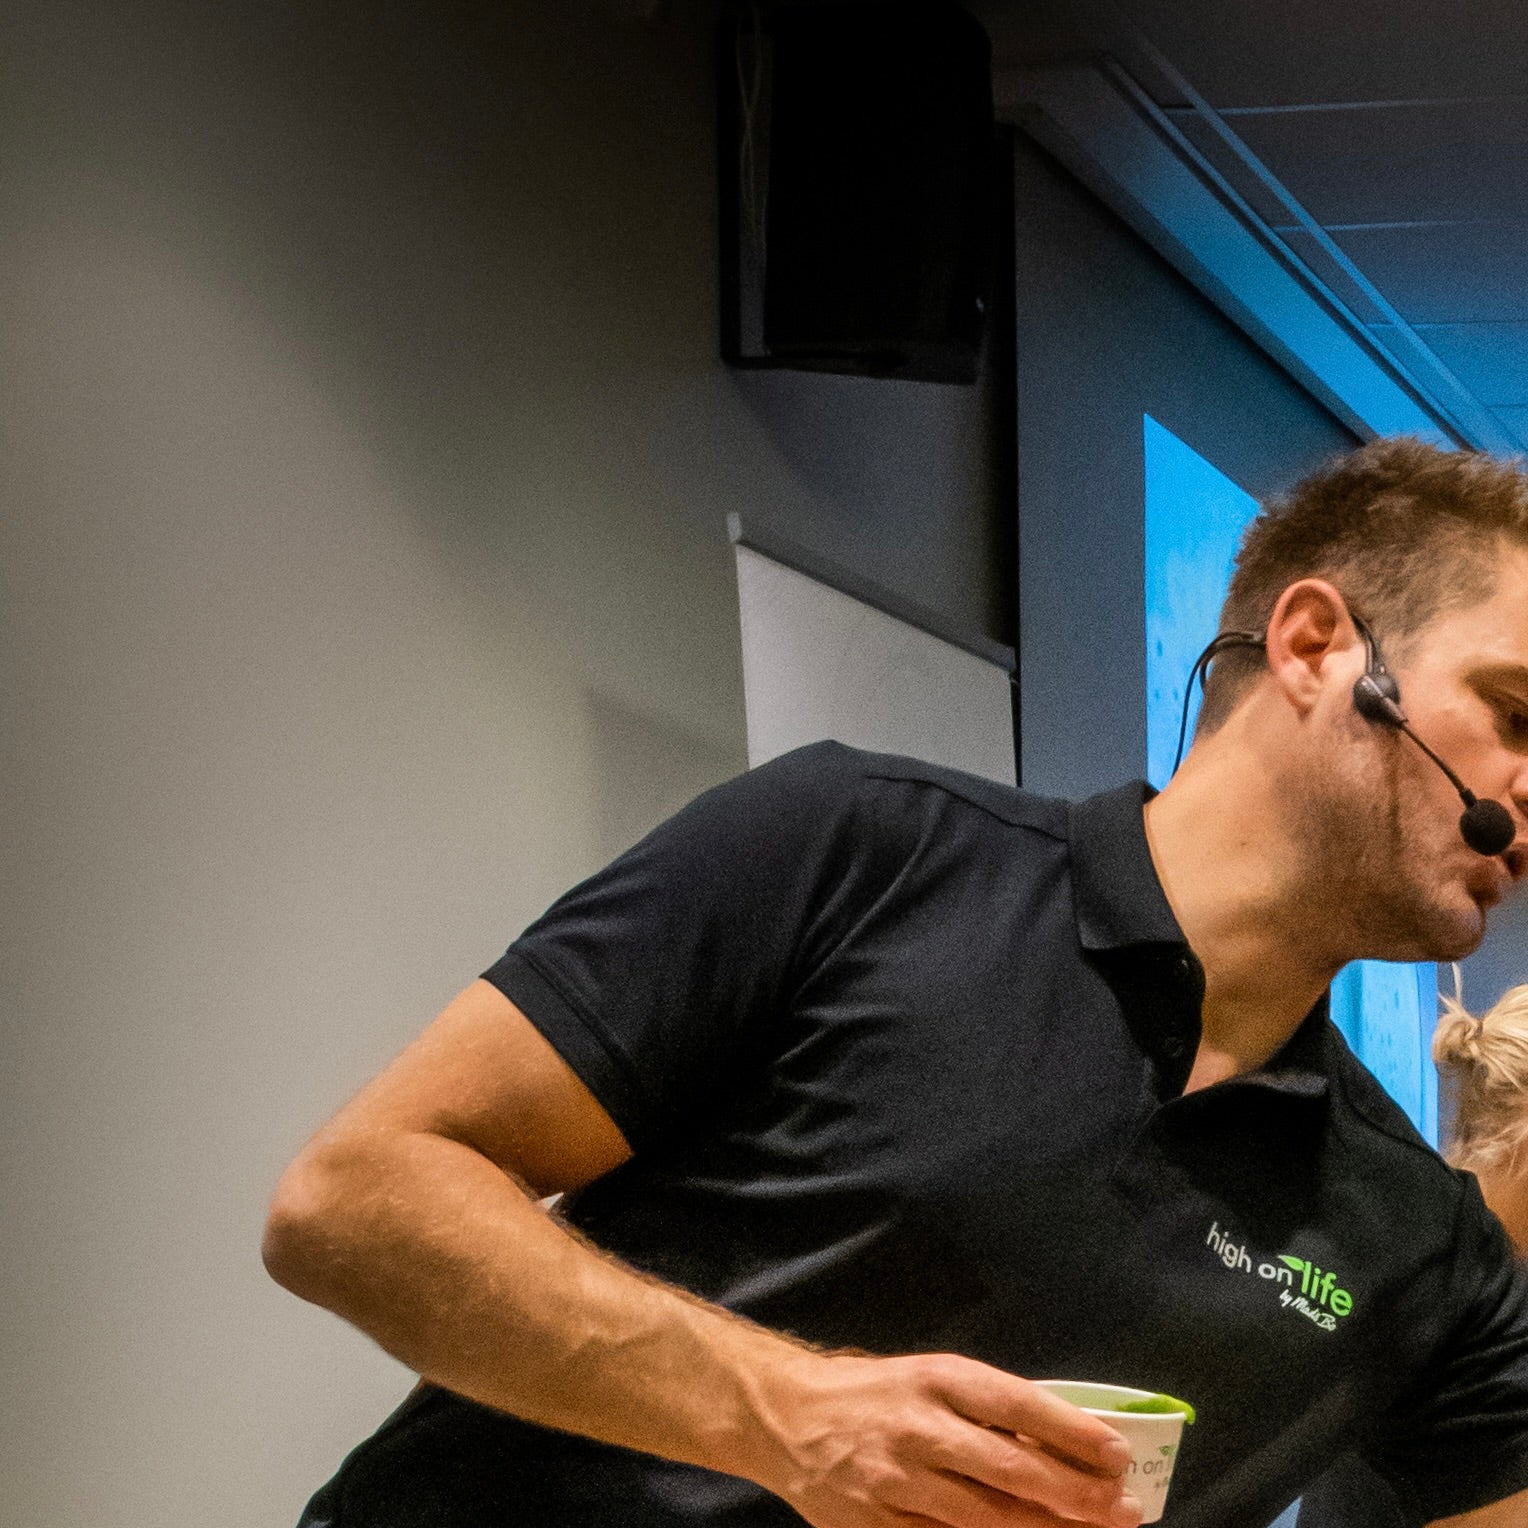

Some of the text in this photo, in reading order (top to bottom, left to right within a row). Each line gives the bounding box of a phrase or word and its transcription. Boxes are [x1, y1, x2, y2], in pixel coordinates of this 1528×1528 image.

[1206, 1221, 1353, 1317] high on life
